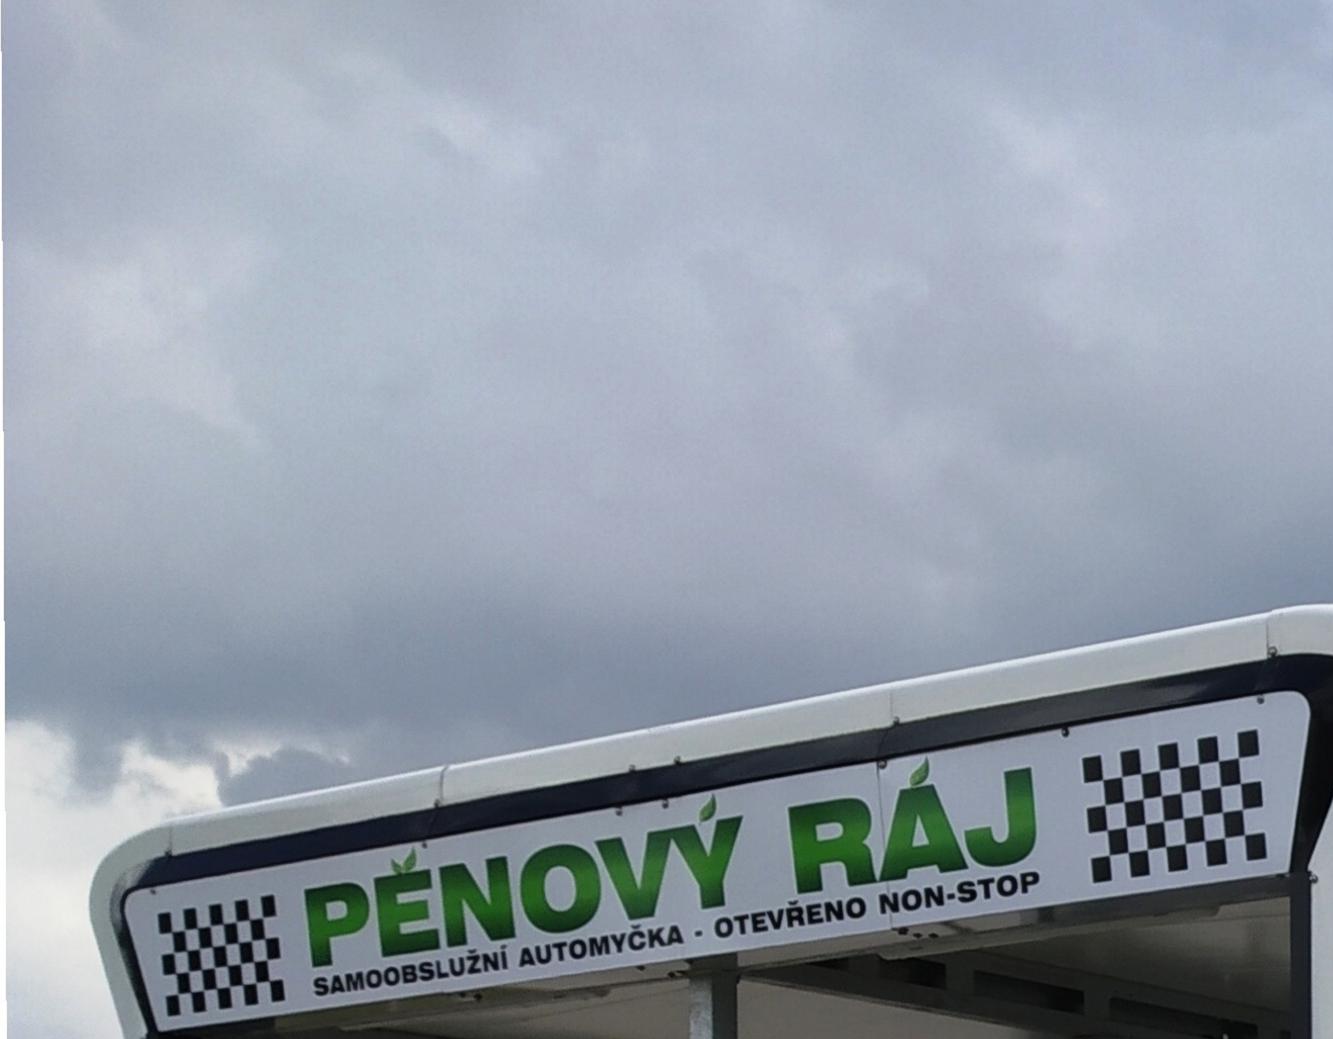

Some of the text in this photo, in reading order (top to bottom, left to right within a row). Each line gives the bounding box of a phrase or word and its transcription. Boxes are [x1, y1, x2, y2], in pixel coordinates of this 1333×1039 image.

[304, 757, 1037, 968] PĚNOVÝ RÁJ
[313, 944, 508, 997] SAMOOBSLUŽNÍ
[519, 923, 685, 968] AUTOMYČKA
[714, 898, 867, 939] OTEVŘENO
[879, 871, 1041, 915] NON-STOP
